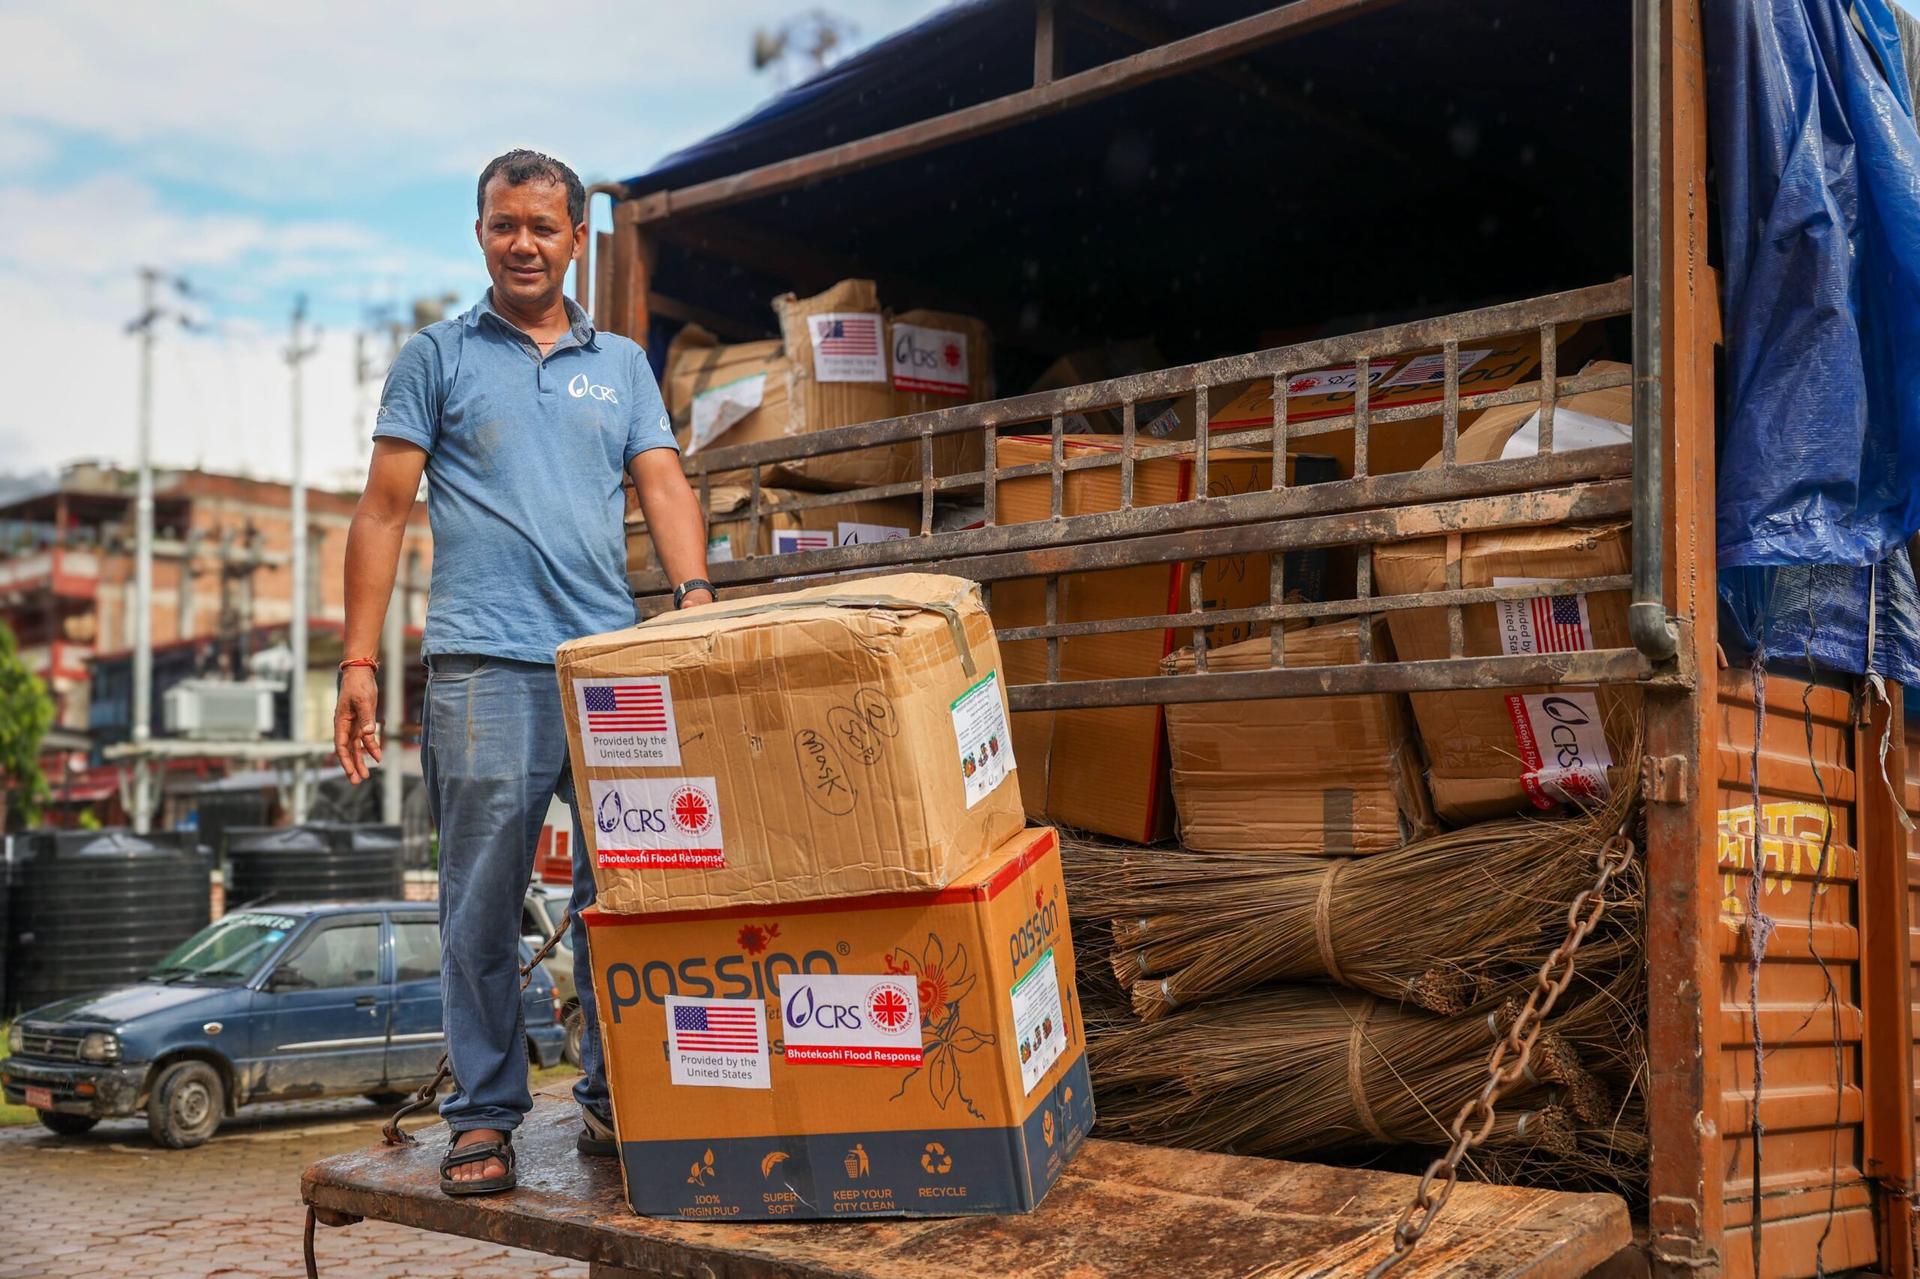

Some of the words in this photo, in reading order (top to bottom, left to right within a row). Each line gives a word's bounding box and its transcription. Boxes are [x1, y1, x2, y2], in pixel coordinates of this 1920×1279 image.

[589, 384, 619, 405] CRS
[1517, 598, 1531, 638] rovided
[1508, 634, 1519, 655] Stat
[1520, 640, 1532, 654] by
[1510, 696, 1532, 750] Bhotekoshi
[593, 735, 634, 746] Provided
[637, 736, 648, 748] by
[650, 735, 667, 746] the
[1551, 725, 1583, 768] CRS
[600, 748, 631, 759] United
[633, 748, 664, 759] States
[623, 808, 666, 833] CRS
[599, 854, 649, 864] Bhotekoshi
[651, 854, 678, 863] Flood
[680, 854, 723, 866] Response
[1010, 899, 1059, 980] passion
[815, 1004, 861, 1030] CRS
[681, 1055, 724, 1066] Provided
[726, 1056, 738, 1069] by
[740, 1057, 757, 1067] the
[787, 1049, 843, 1060] Bhotekoshi
[844, 1050, 873, 1061] Flood
[874, 1050, 921, 1063] Response
[687, 1068, 720, 1078] United
[722, 1069, 753, 1080] States
[762, 1192, 797, 1203] SUPER
[833, 1190, 860, 1200] KEEP
[861, 1188, 893, 1199] YOUR
[918, 1186, 967, 1198] RECYCLE
[695, 1195, 720, 1205] 100%
[833, 1202, 858, 1212] CITY
[860, 1201, 896, 1211] CLEAN
[679, 1206, 712, 1217] VIRGIN
[713, 1206, 740, 1217] PULP
[767, 1204, 795, 1215] SOFT
